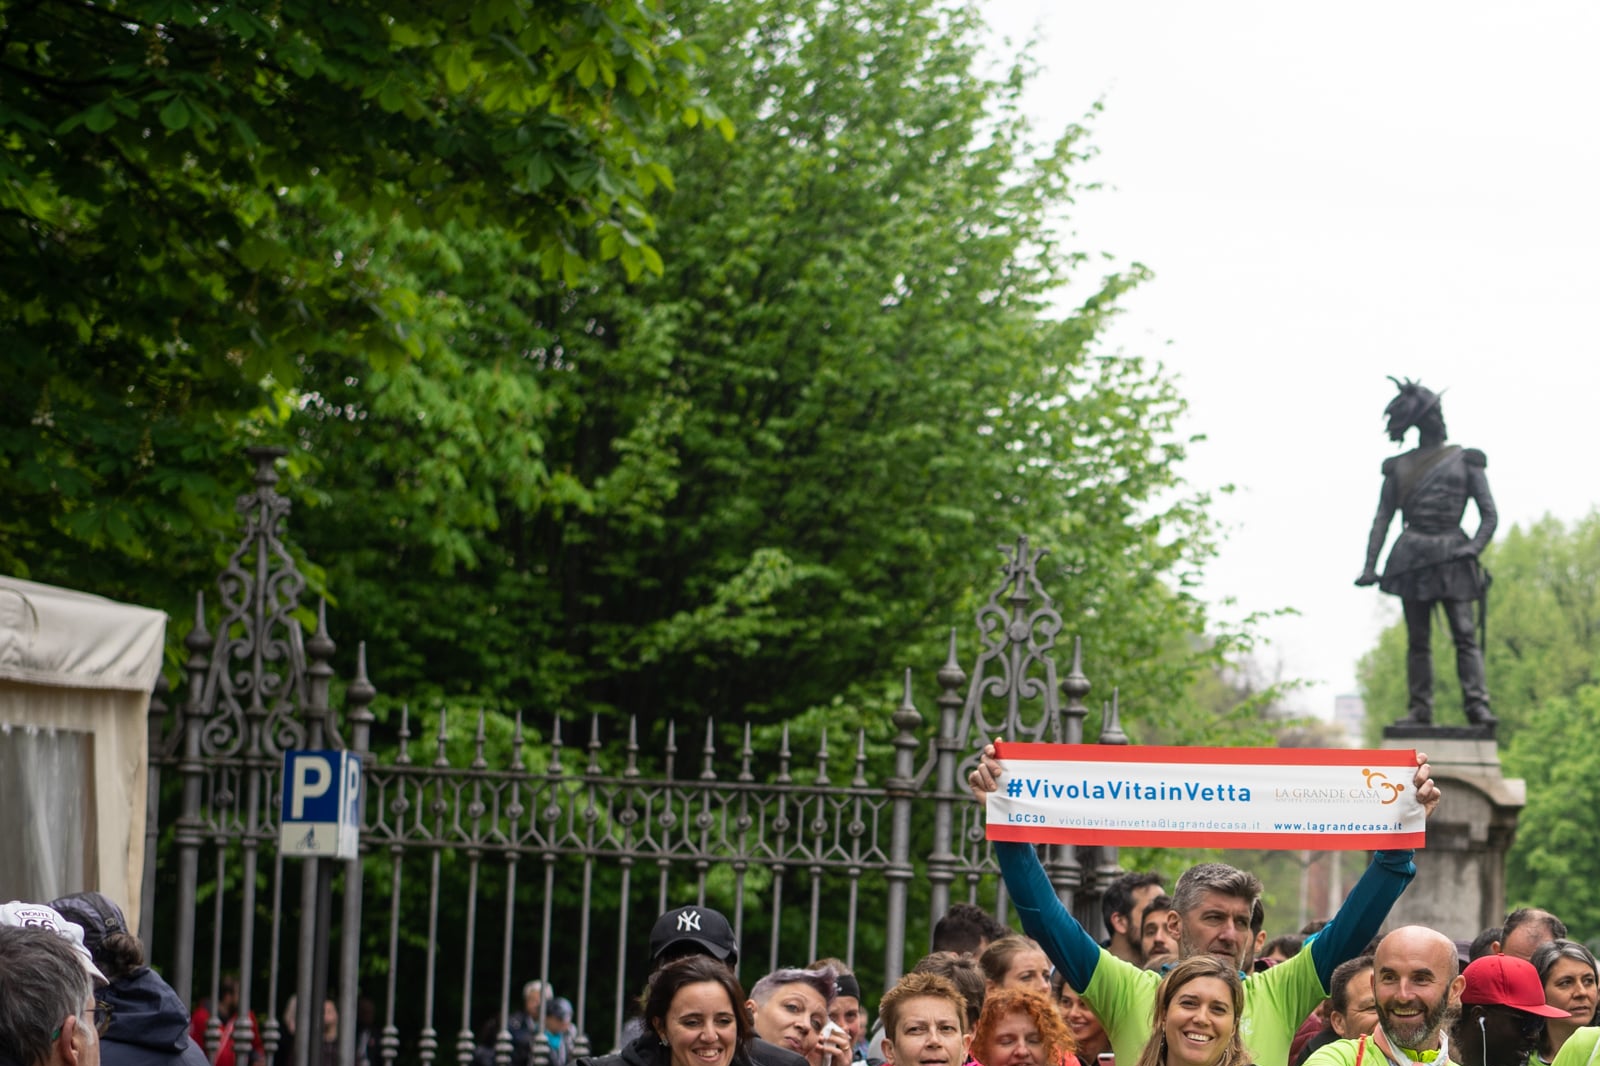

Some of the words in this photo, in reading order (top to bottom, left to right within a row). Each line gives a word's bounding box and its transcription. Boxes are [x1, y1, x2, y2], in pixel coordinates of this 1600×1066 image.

[291, 755, 332, 819] P
[345, 758, 360, 823] P
[1006, 778, 1252, 802] #VivolaVitainVetta
[1275, 788, 1290, 798] LA
[1292, 788, 1346, 799] GRANDE
[1349, 788, 1381, 799] CASA
[1008, 813, 1047, 824] LGC30
[1059, 816, 1261, 831] vivolavitainvetta@lagrandecasa.it
[1274, 821, 1403, 833] www.lagrandecasa.it
